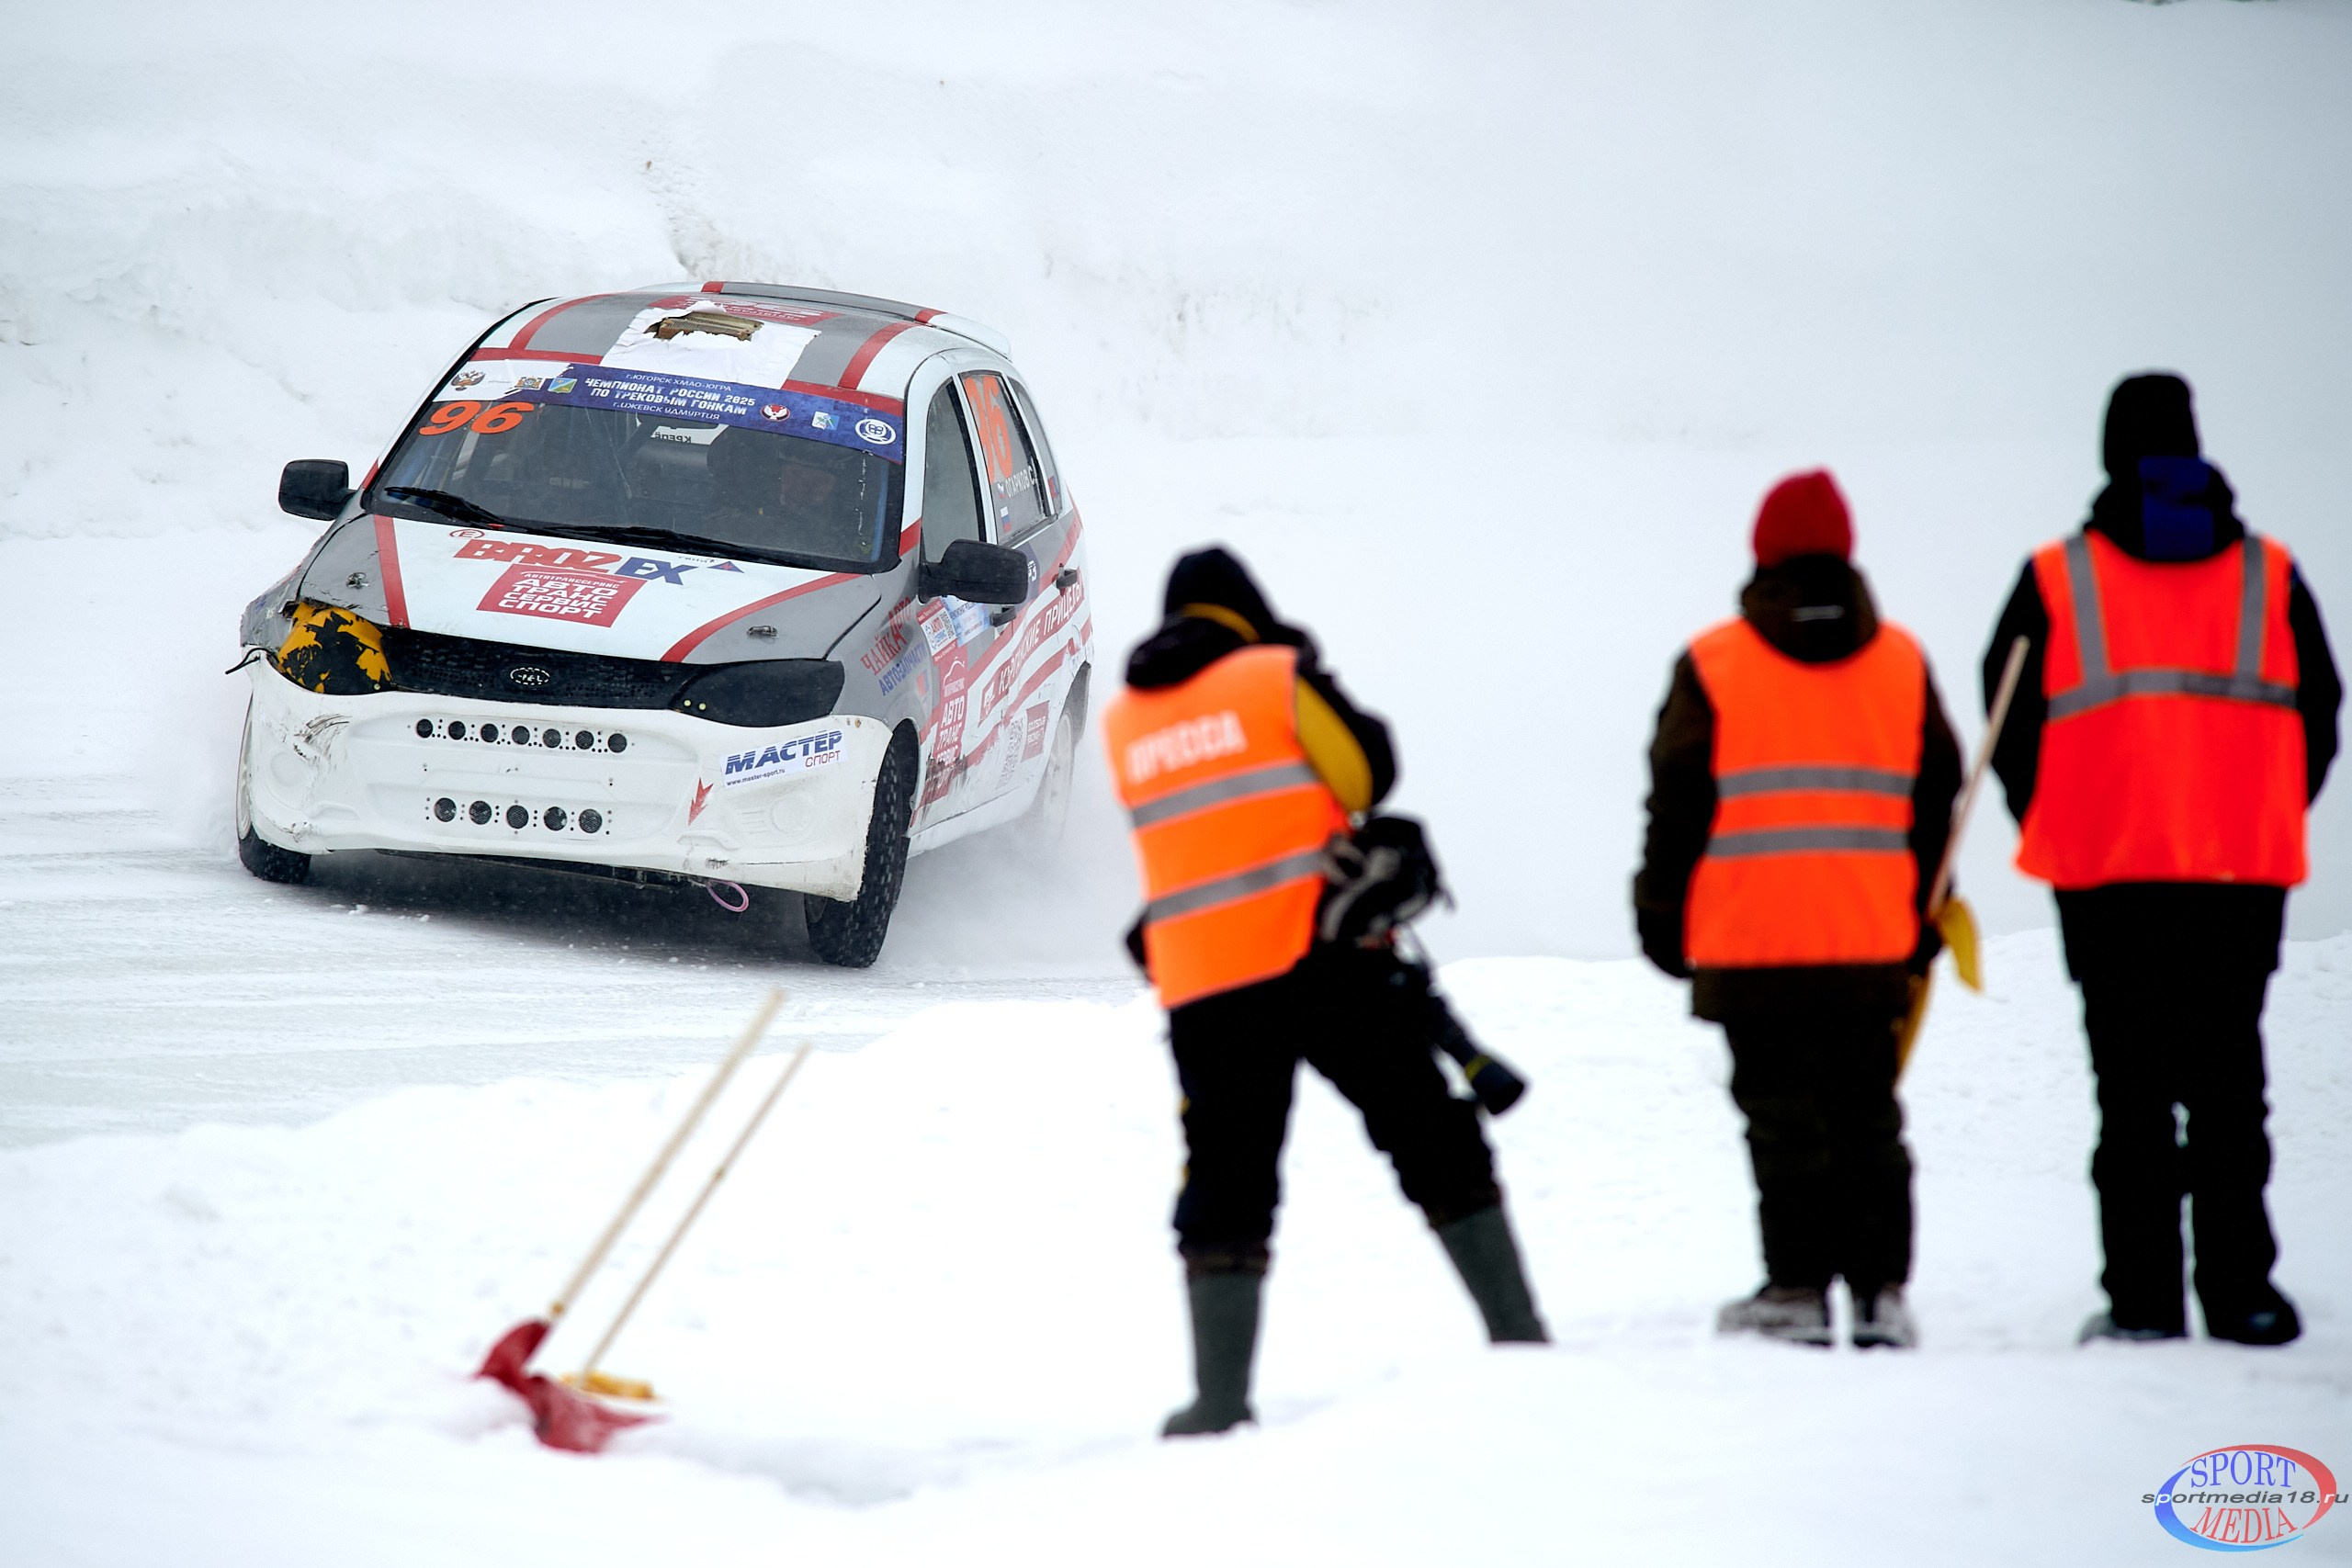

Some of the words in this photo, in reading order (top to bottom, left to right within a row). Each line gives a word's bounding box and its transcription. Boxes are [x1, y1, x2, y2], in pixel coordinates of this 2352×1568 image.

[585, 378, 665, 394] ЧЕМПИОНАТ
[670, 388, 720, 401] РОССИИ
[724, 395, 756, 406] 2025
[626, 374, 672, 384] г.ЮГОРСК
[673, 377, 731, 392] ХМАО-ЮГРА
[591, 389, 609, 397] ПО
[615, 390, 686, 407] ТРЕКОВЫМ
[690, 400, 748, 415] ГОНКАМ
[419, 400, 535, 435] 96
[665, 407, 720, 421] УДМУРТИЯ
[511, 584, 613, 604] ТРАНС
[516, 578, 618, 597] АВТО
[498, 600, 603, 619] СПОРТ
[503, 592, 607, 611] СЕРВИС
[941, 695, 965, 728] АВТО
[725, 730, 842, 775] МАСТЕР
[805, 750, 841, 768] СПОРТ
[727, 768, 786, 786] www.master-sport.ru
